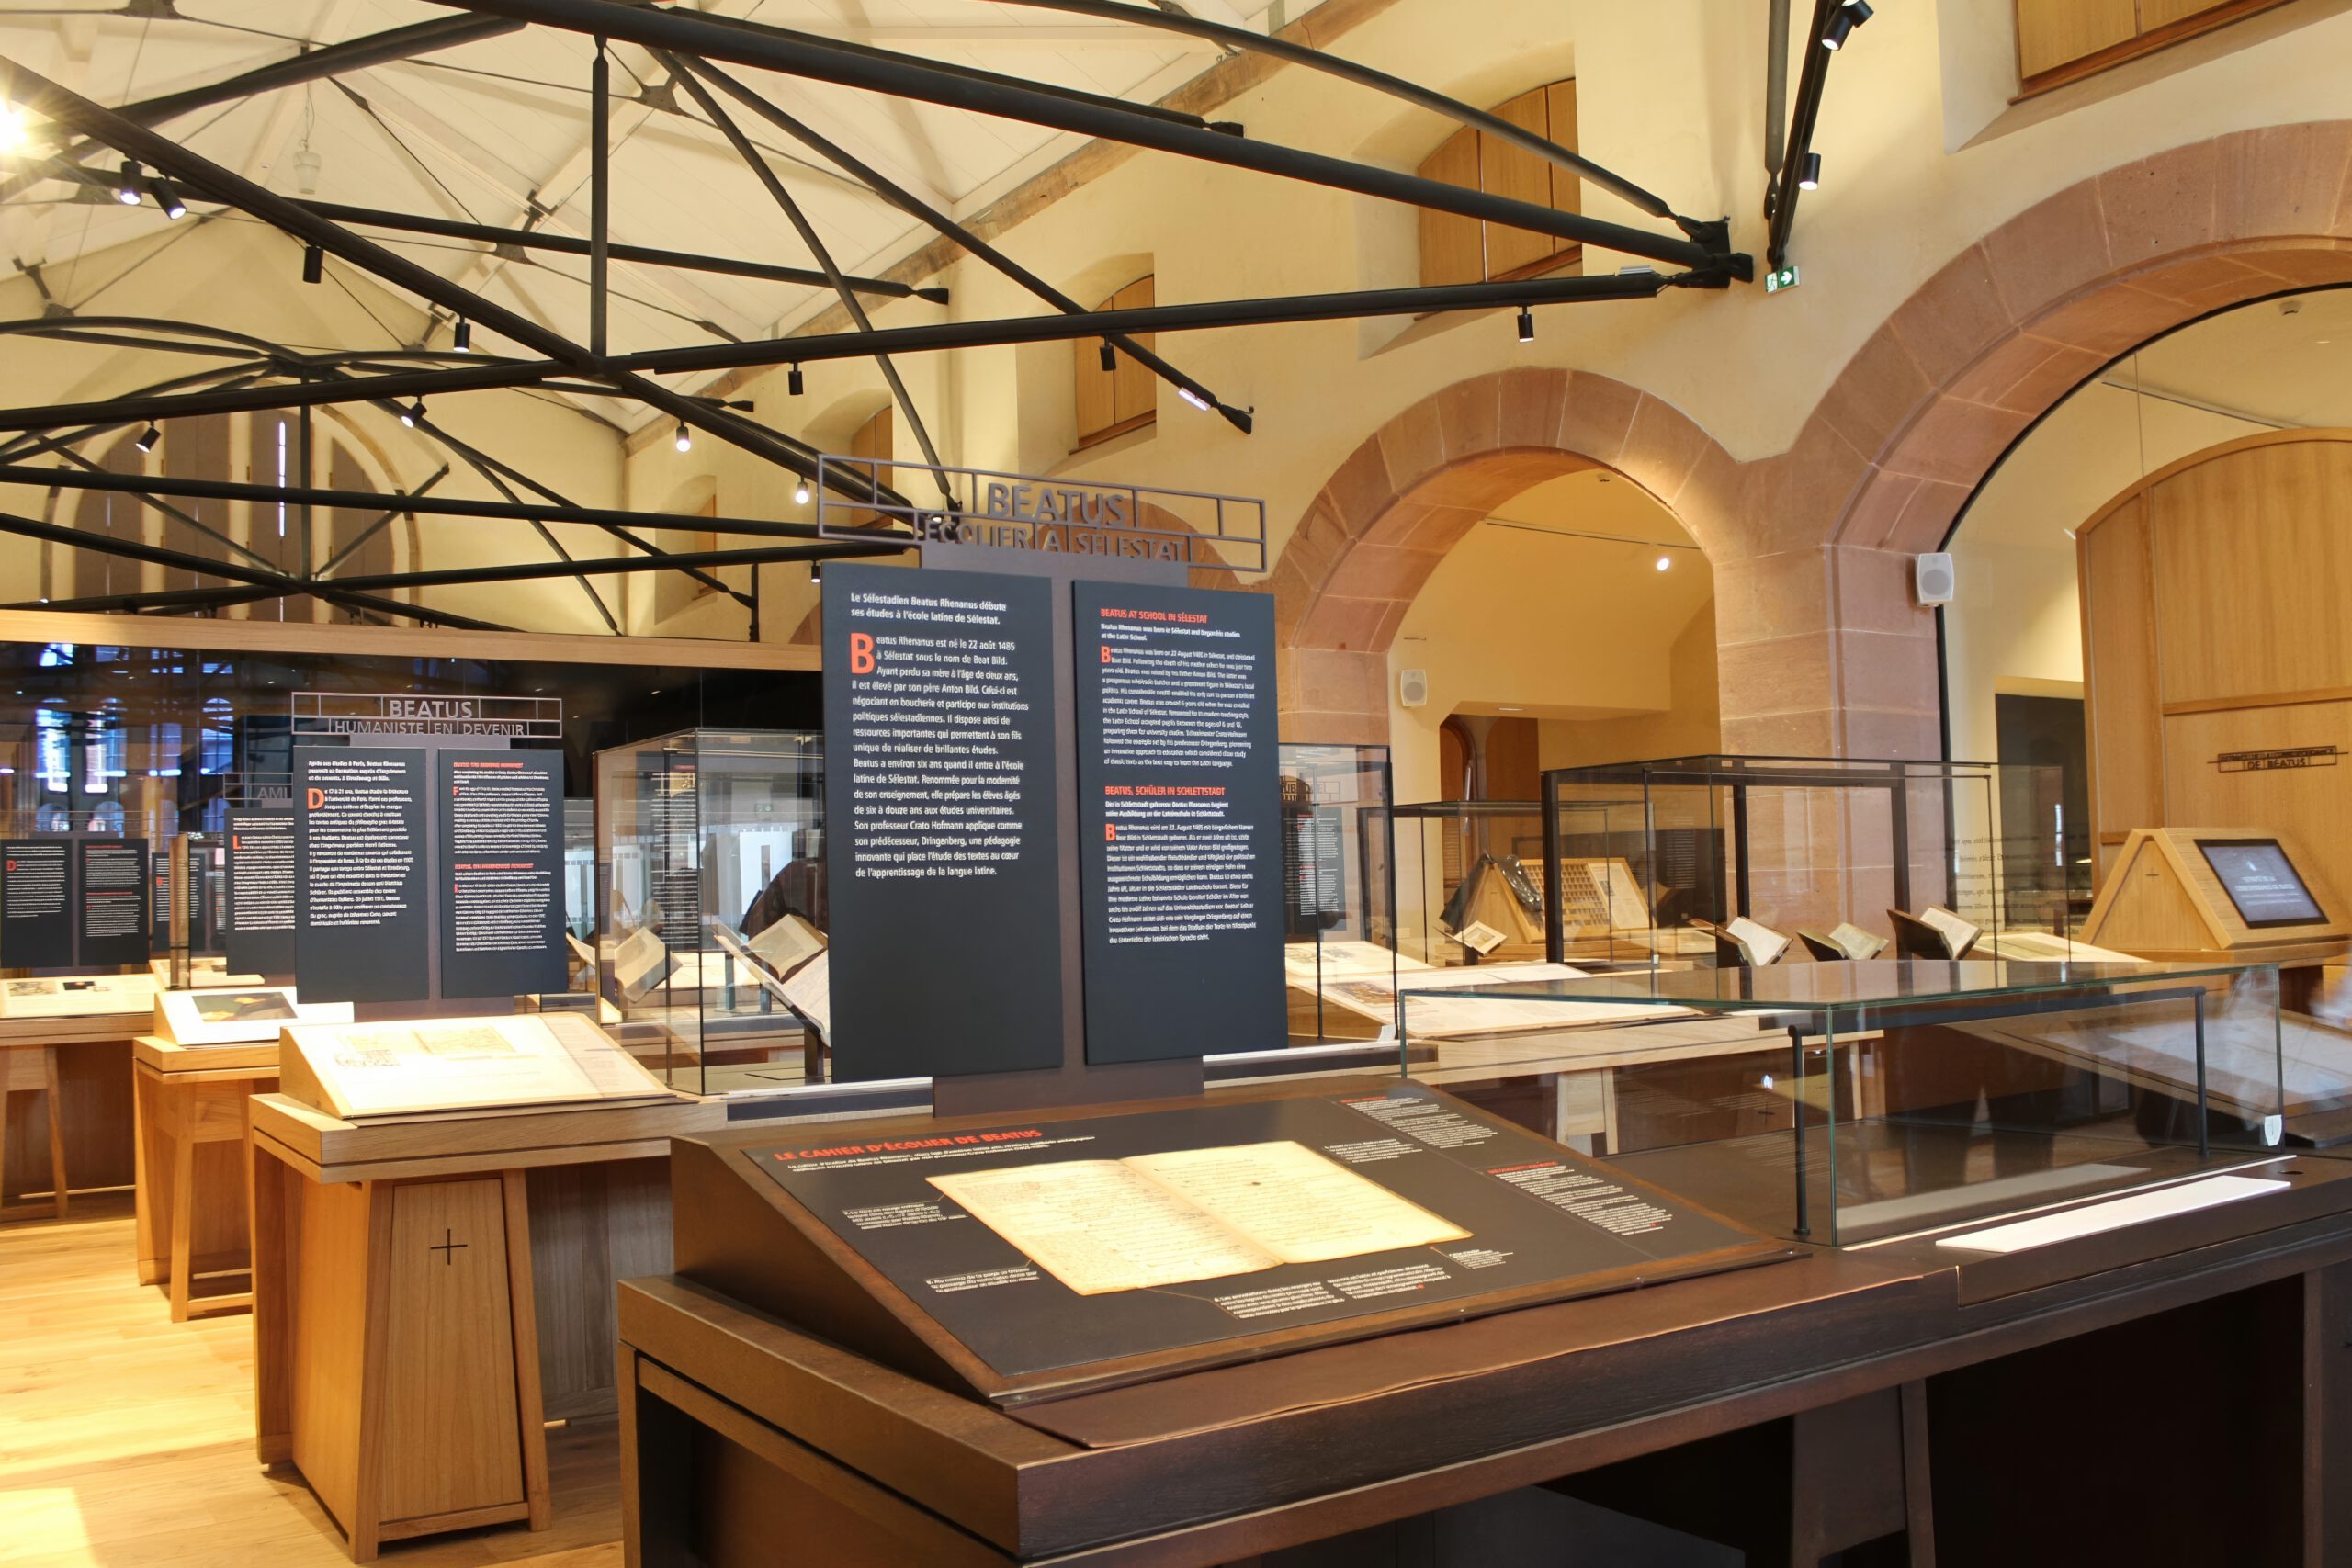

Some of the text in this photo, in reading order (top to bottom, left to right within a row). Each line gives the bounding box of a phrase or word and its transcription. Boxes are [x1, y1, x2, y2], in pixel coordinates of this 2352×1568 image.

[988, 482, 1126, 526] BEATUS
[851, 592, 1006, 612] Le Sélestadien Beatus Rhenanus débute
[851, 607, 1001, 626] ses études à l'école latine de Sélestat.
[1100, 607, 1208, 624] BEATUS AT SCHOOL IN SÉLESTAT
[876, 635, 1015, 651] eatus Rhenanus est né le 22 août 1485
[876, 649, 1008, 666] à Sélestat sous le nom de Beat Bild.
[876, 664, 899, 679] Ayant
[950, 668, 956, 679] à
[956, 668, 974, 682] l'âge
[974, 669, 985, 680] de
[852, 679, 857, 691] il
[858, 681, 871, 691] est
[871, 680, 892, 692] élevé
[893, 683, 906, 694] par
[908, 683, 922, 693] son
[941, 682, 963, 694] Anton
[964, 683, 981, 694] Bild.
[390, 699, 472, 719] BEATUS
[852, 694, 888, 709] négociant
[888, 698, 899, 707] en
[899, 696, 935, 708] boucherie
[936, 698, 944, 708] et
[944, 698, 976, 712] participe
[853, 710, 888, 725] politiques
[946, 713, 953, 724] Il
[954, 713, 981, 728] dispose
[982, 715, 1000, 725] ainsi
[1000, 714, 1010, 726] de
[334, 720, 524, 737] HUMANISTE EN DEVENIR
[853, 728, 891, 738] ressources
[891, 728, 936, 741] importantes
[936, 728, 949, 741] qui
[950, 729, 989, 742] permettent
[996, 731, 1011, 740] son
[853, 742, 999, 755] unique de réaliser de brillantes études.
[853, 757, 1023, 773] Beatus a environ six ans quand il entre à l'école
[854, 773, 875, 784] latine
[876, 773, 887, 784] de
[888, 773, 921, 784] Sélestat.
[960, 776, 978, 787] pour
[978, 773, 985, 785] la
[854, 788, 864, 799] de
[864, 791, 878, 799] son
[930, 789, 944, 800] elle
[944, 789, 970, 803] prépare
[1104, 784, 1226, 796] BEATUS, SCHÜLER IN SCHLETTSTADT
[854, 804, 1014, 816] de six à douze ans aux études universitaires.
[854, 819, 1022, 833] Son professeur Crato Hofmann applique comme
[854, 838, 869, 846] son
[968, 837, 982, 846] une
[983, 834, 1020, 848] pédagogie
[854, 850, 1018, 864] innovante qui place l'étude des textes au cœur
[855, 864, 997, 880] de l'apprentissage de la langue latine.
[774, 1128, 1043, 1161] LE CAHIER D'ÉCOLIER DE BEATUS
